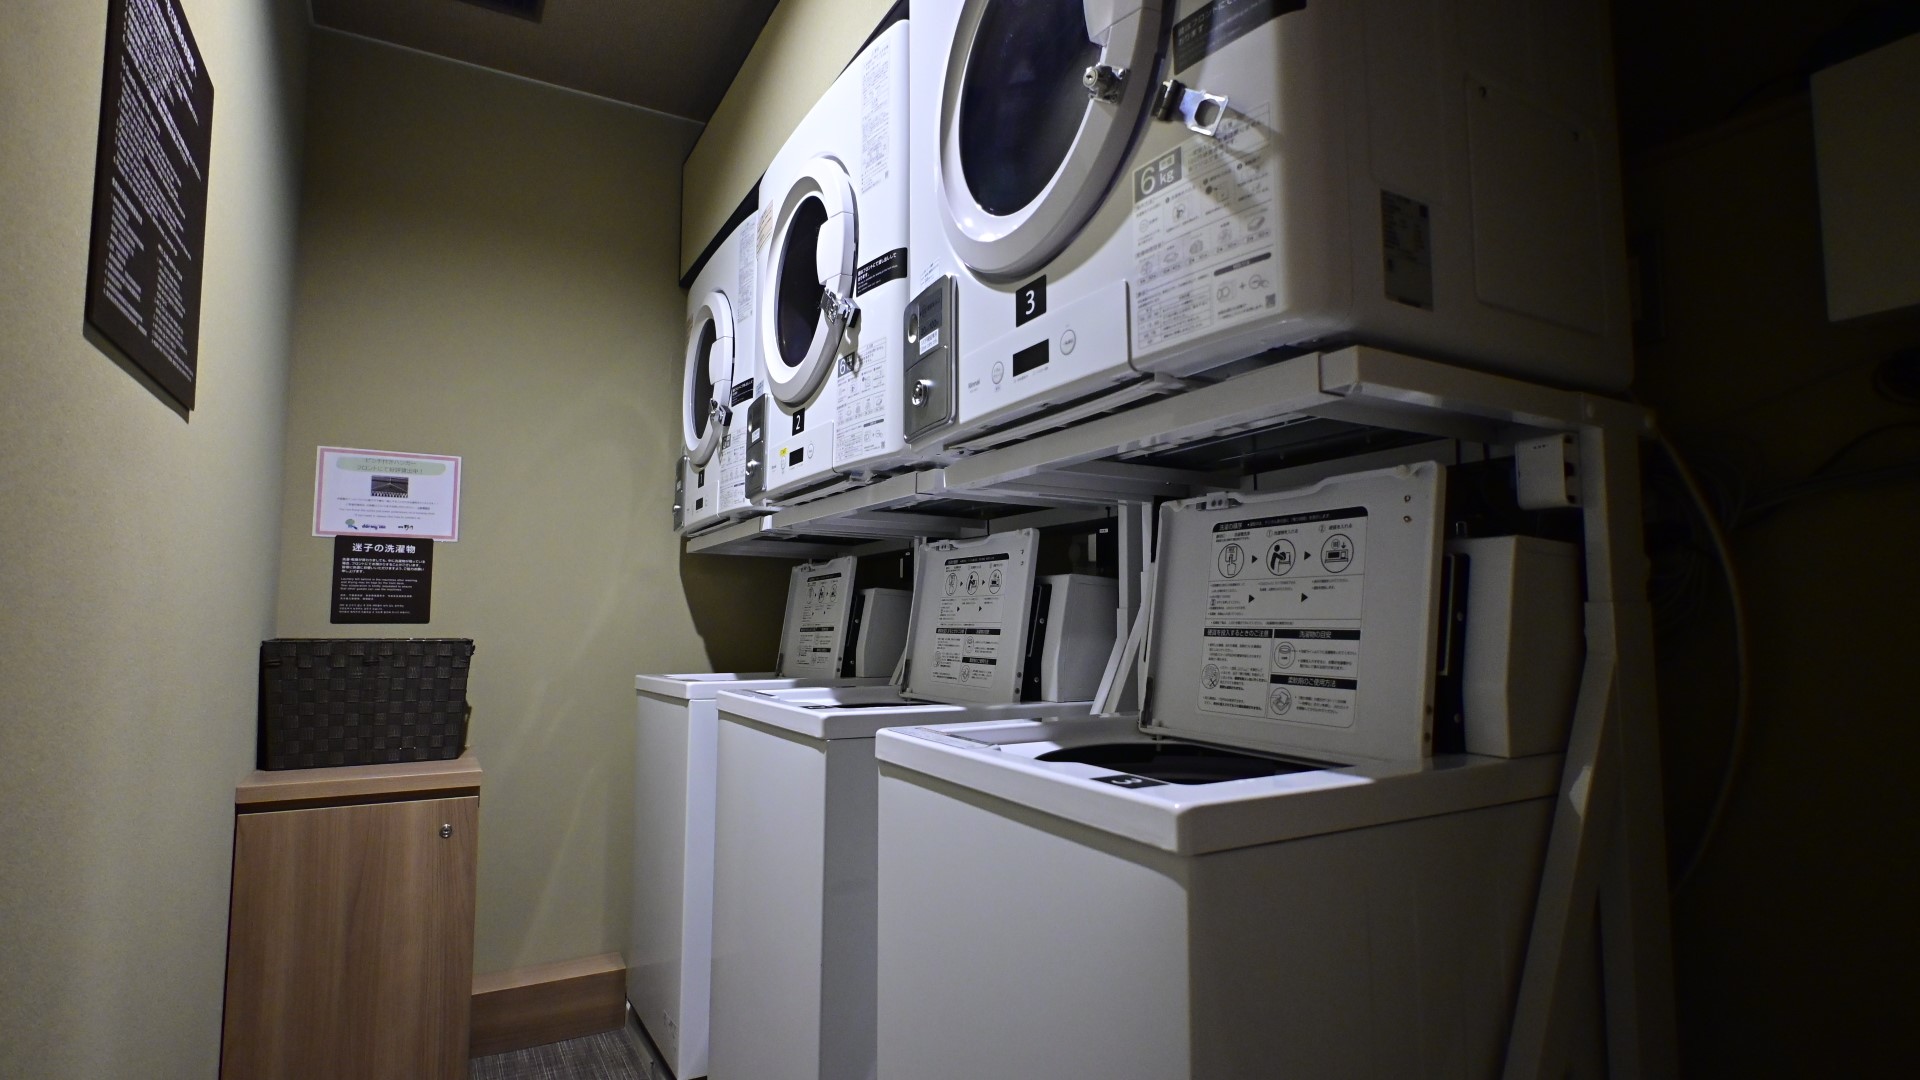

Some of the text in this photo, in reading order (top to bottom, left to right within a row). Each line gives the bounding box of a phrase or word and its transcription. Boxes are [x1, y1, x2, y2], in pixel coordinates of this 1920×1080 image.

[1140, 166, 1156, 195] 6
[1159, 170, 1174, 185] kg
[1025, 290, 1036, 315] 3
[795, 414, 802, 430] 2
[352, 542, 416, 554] 迷子の洗濯物
